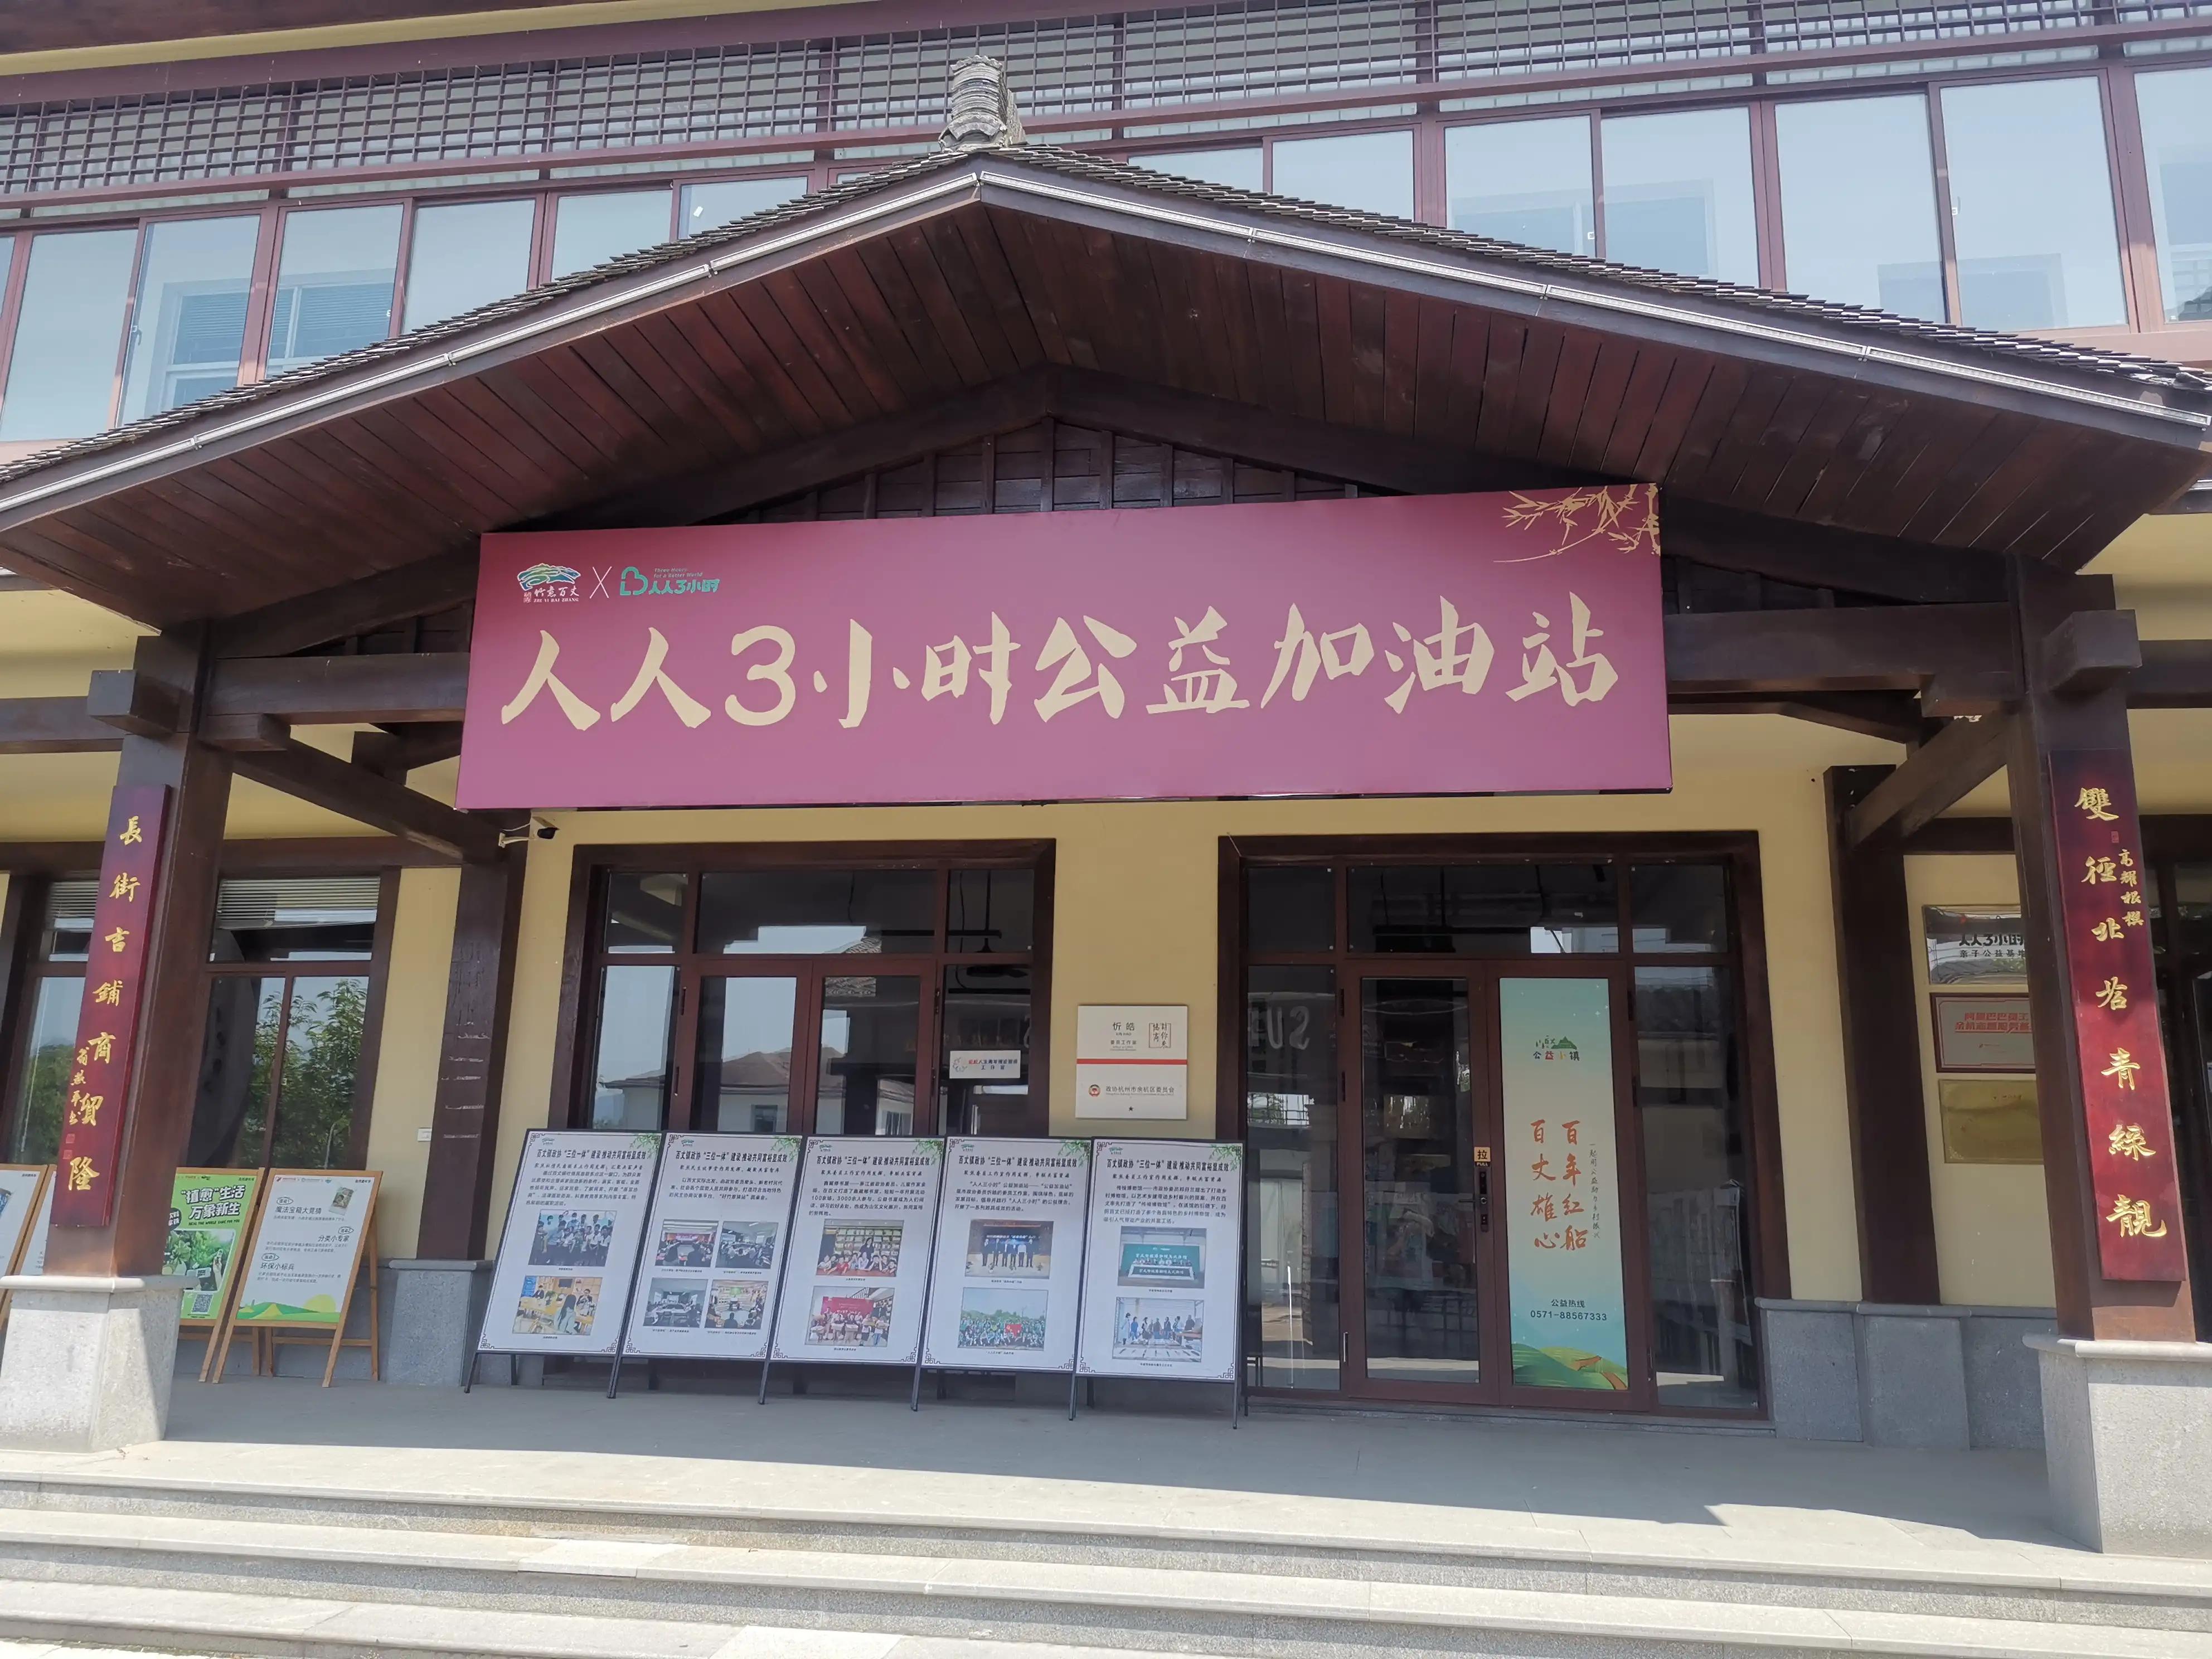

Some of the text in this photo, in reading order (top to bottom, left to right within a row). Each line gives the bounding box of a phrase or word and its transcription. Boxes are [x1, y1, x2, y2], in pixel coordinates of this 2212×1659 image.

[501, 591, 1619, 730] 人人3小时公益加油站
[1477, 1149, 1488, 1160] 拉
[180, 1183, 247, 1205] “植愈”生活
[1530, 1119, 1561, 1249] 百丈雄心
[1560, 1120, 1588, 1251] 百年红船
[188, 1201, 241, 1220] 万象新生
[1550, 1298, 1586, 1308] 公益热线
[1530, 1310, 1608, 1321] 0571-88567333
